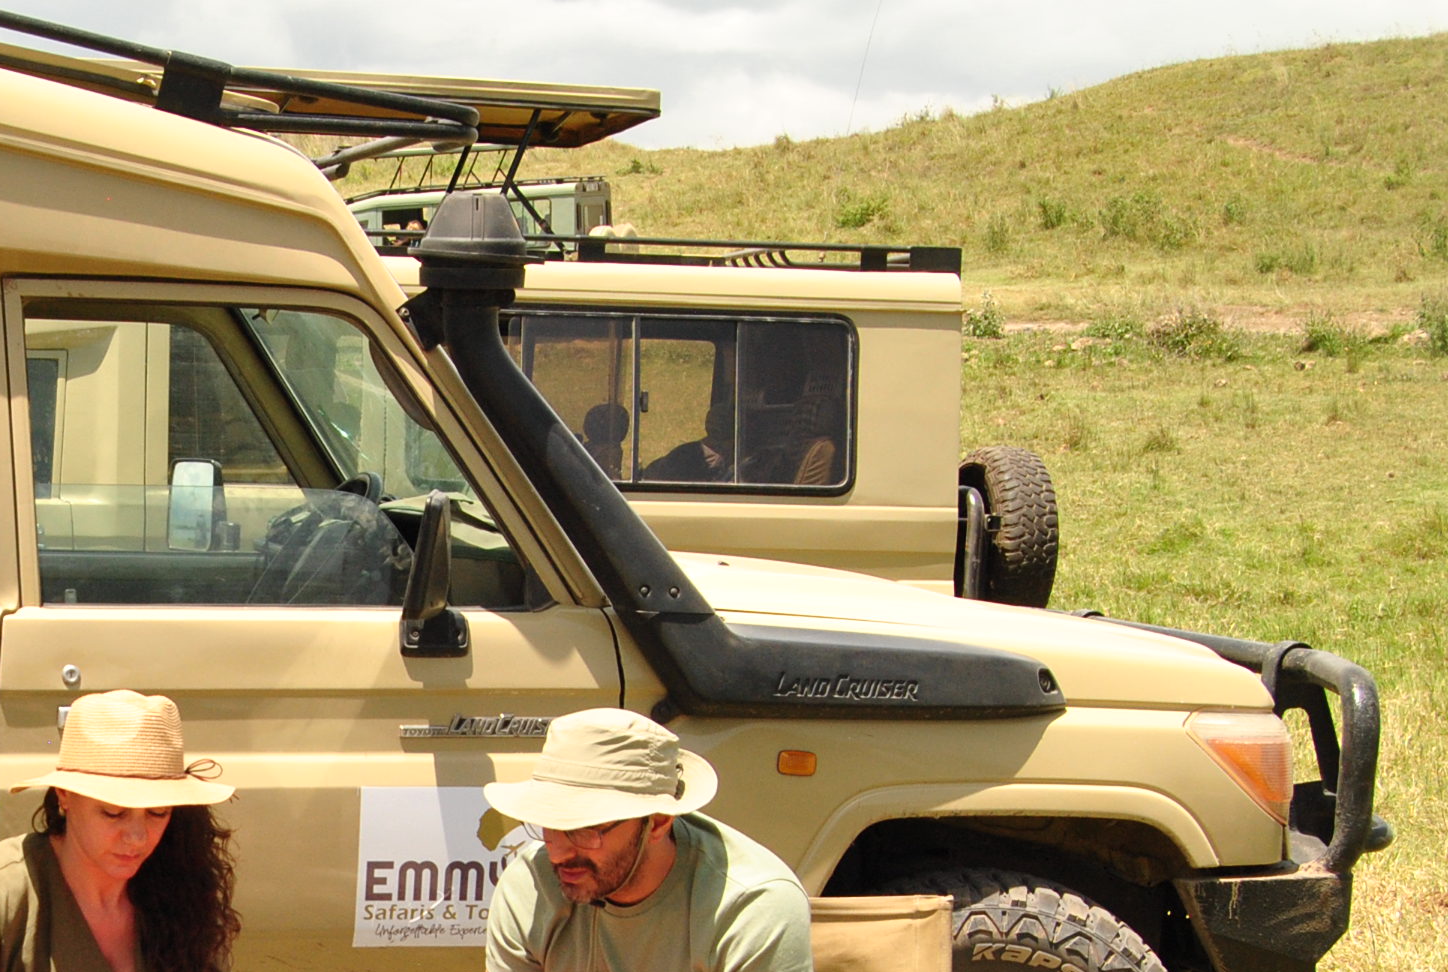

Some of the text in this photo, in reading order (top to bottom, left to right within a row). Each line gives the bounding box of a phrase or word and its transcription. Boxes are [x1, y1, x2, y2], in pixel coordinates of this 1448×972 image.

[773, 672, 920, 701] LAND CRUISER
[495, 713, 550, 736] CRUIS
[363, 904, 434, 921] Safaris
[442, 904, 457, 921] &
